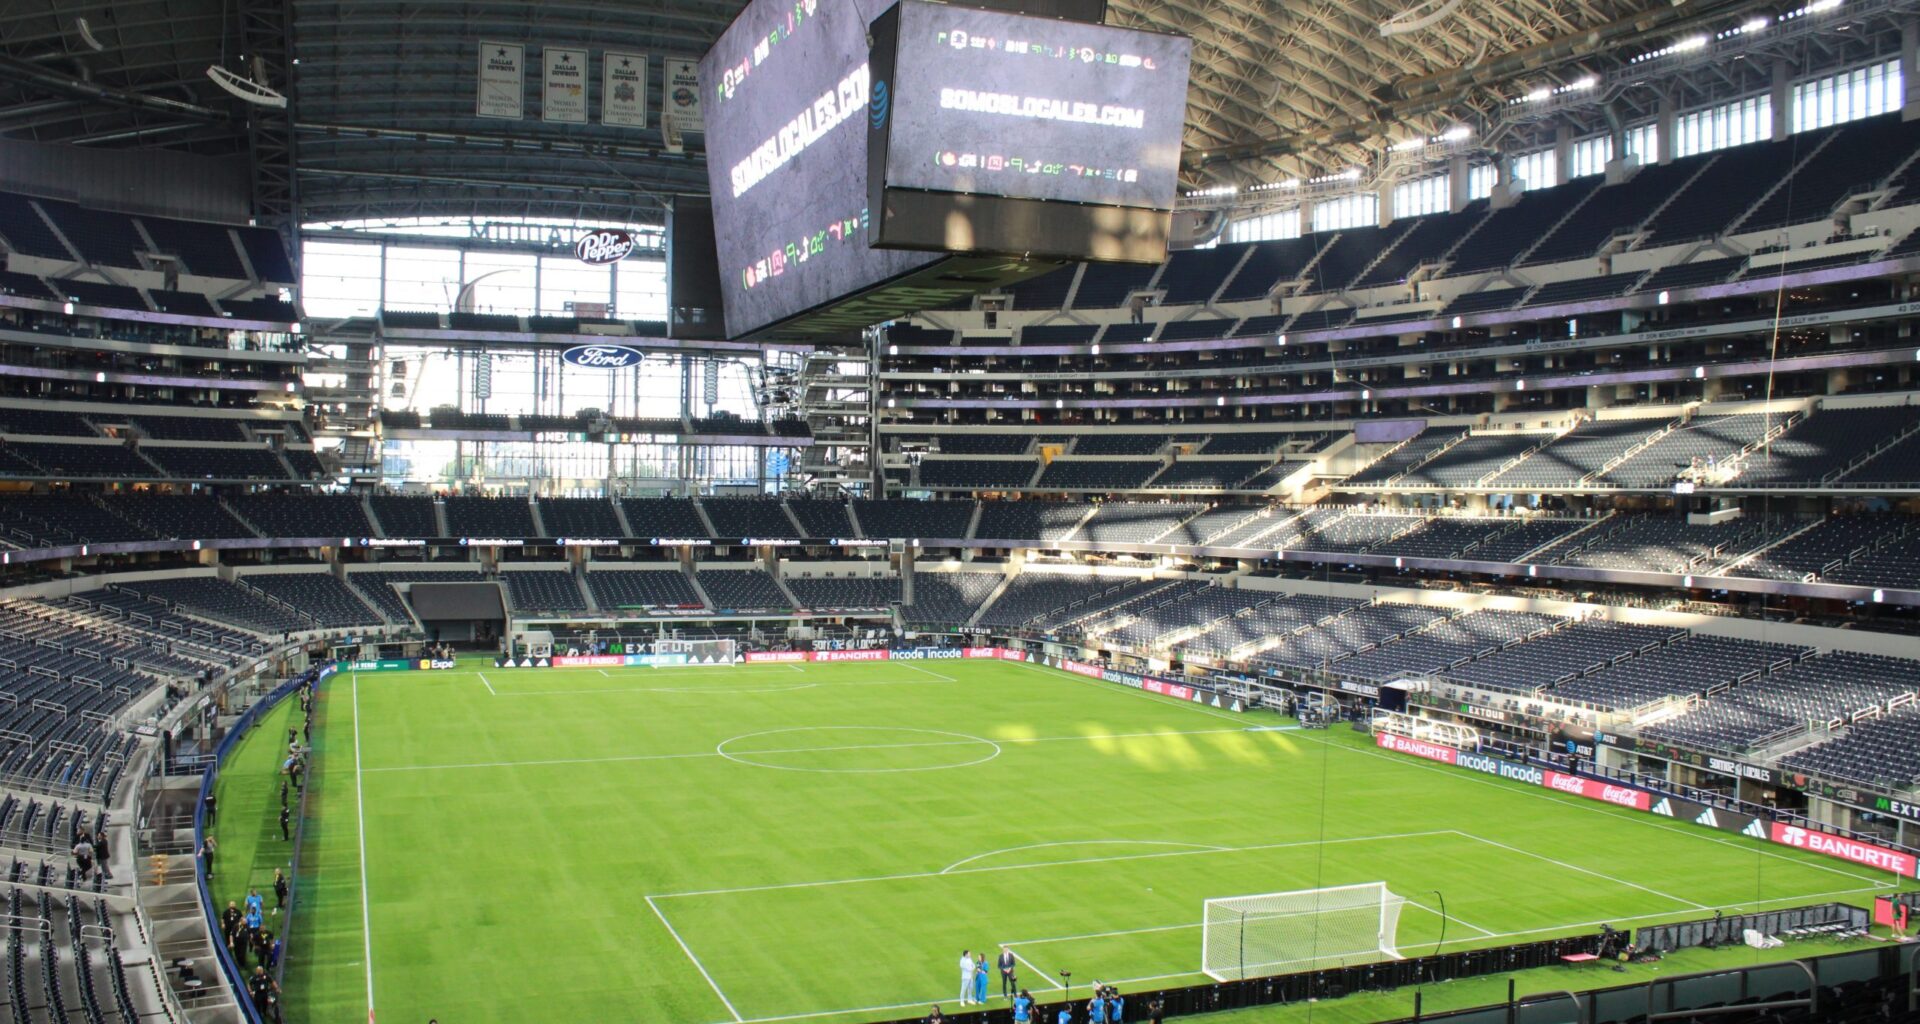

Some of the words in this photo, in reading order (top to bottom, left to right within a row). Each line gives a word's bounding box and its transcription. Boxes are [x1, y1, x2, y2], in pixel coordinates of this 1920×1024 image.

[490, 58, 513, 66] DALLAS
[487, 64, 516, 72] COWBOYS
[614, 68, 637, 76] DALLAS
[612, 74, 639, 82] COWBOYS
[941, 87, 1144, 128] SOMOSLOCALES.COM
[599, 232, 619, 248] Dr
[578, 234, 630, 262] Pepper
[577, 347, 630, 366] Ford
[545, 432, 569, 442] MEX
[630, 433, 652, 443] AUS
[950, 626, 992, 635] MEXTOUR
[591, 656, 618, 664] FARGO
[830, 651, 883, 660] BANORTE
[890, 650, 924, 660] incode
[928, 649, 962, 658] incode
[1123, 675, 1143, 688] incode
[1460, 703, 1504, 720] MEXTOUR
[1602, 734, 1618, 744] AT&T
[1396, 739, 1449, 761] BANORTE
[1575, 745, 1593, 756] AT&T
[1457, 751, 1496, 774] incode
[1500, 760, 1543, 785] incode
[1743, 764, 1770, 782] LOCALES
[1808, 834, 1905, 871] BANORTE
